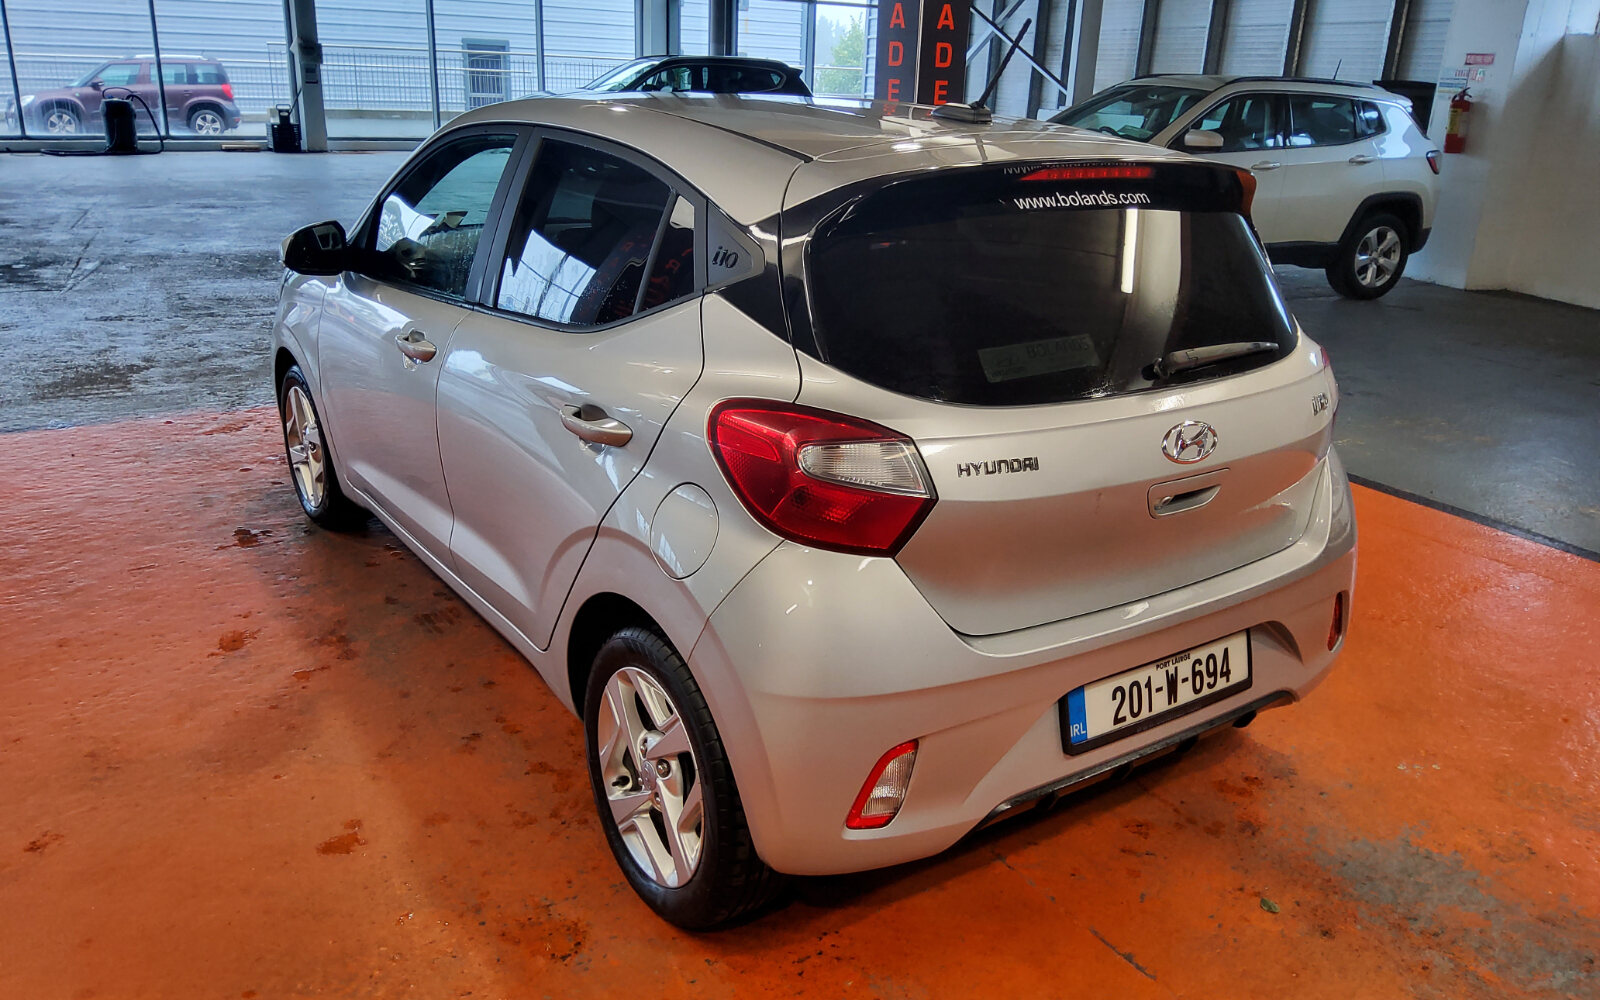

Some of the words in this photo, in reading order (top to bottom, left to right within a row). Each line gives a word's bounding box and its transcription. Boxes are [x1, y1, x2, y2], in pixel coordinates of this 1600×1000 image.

[1013, 190, 1151, 210] www.bolands.com
[711, 245, 739, 269] i10
[956, 456, 1040, 478] HYUNDAI
[1155, 659, 1171, 671] PORT
[1111, 647, 1232, 726] 201-W-694
[1069, 723, 1087, 738] IRL
